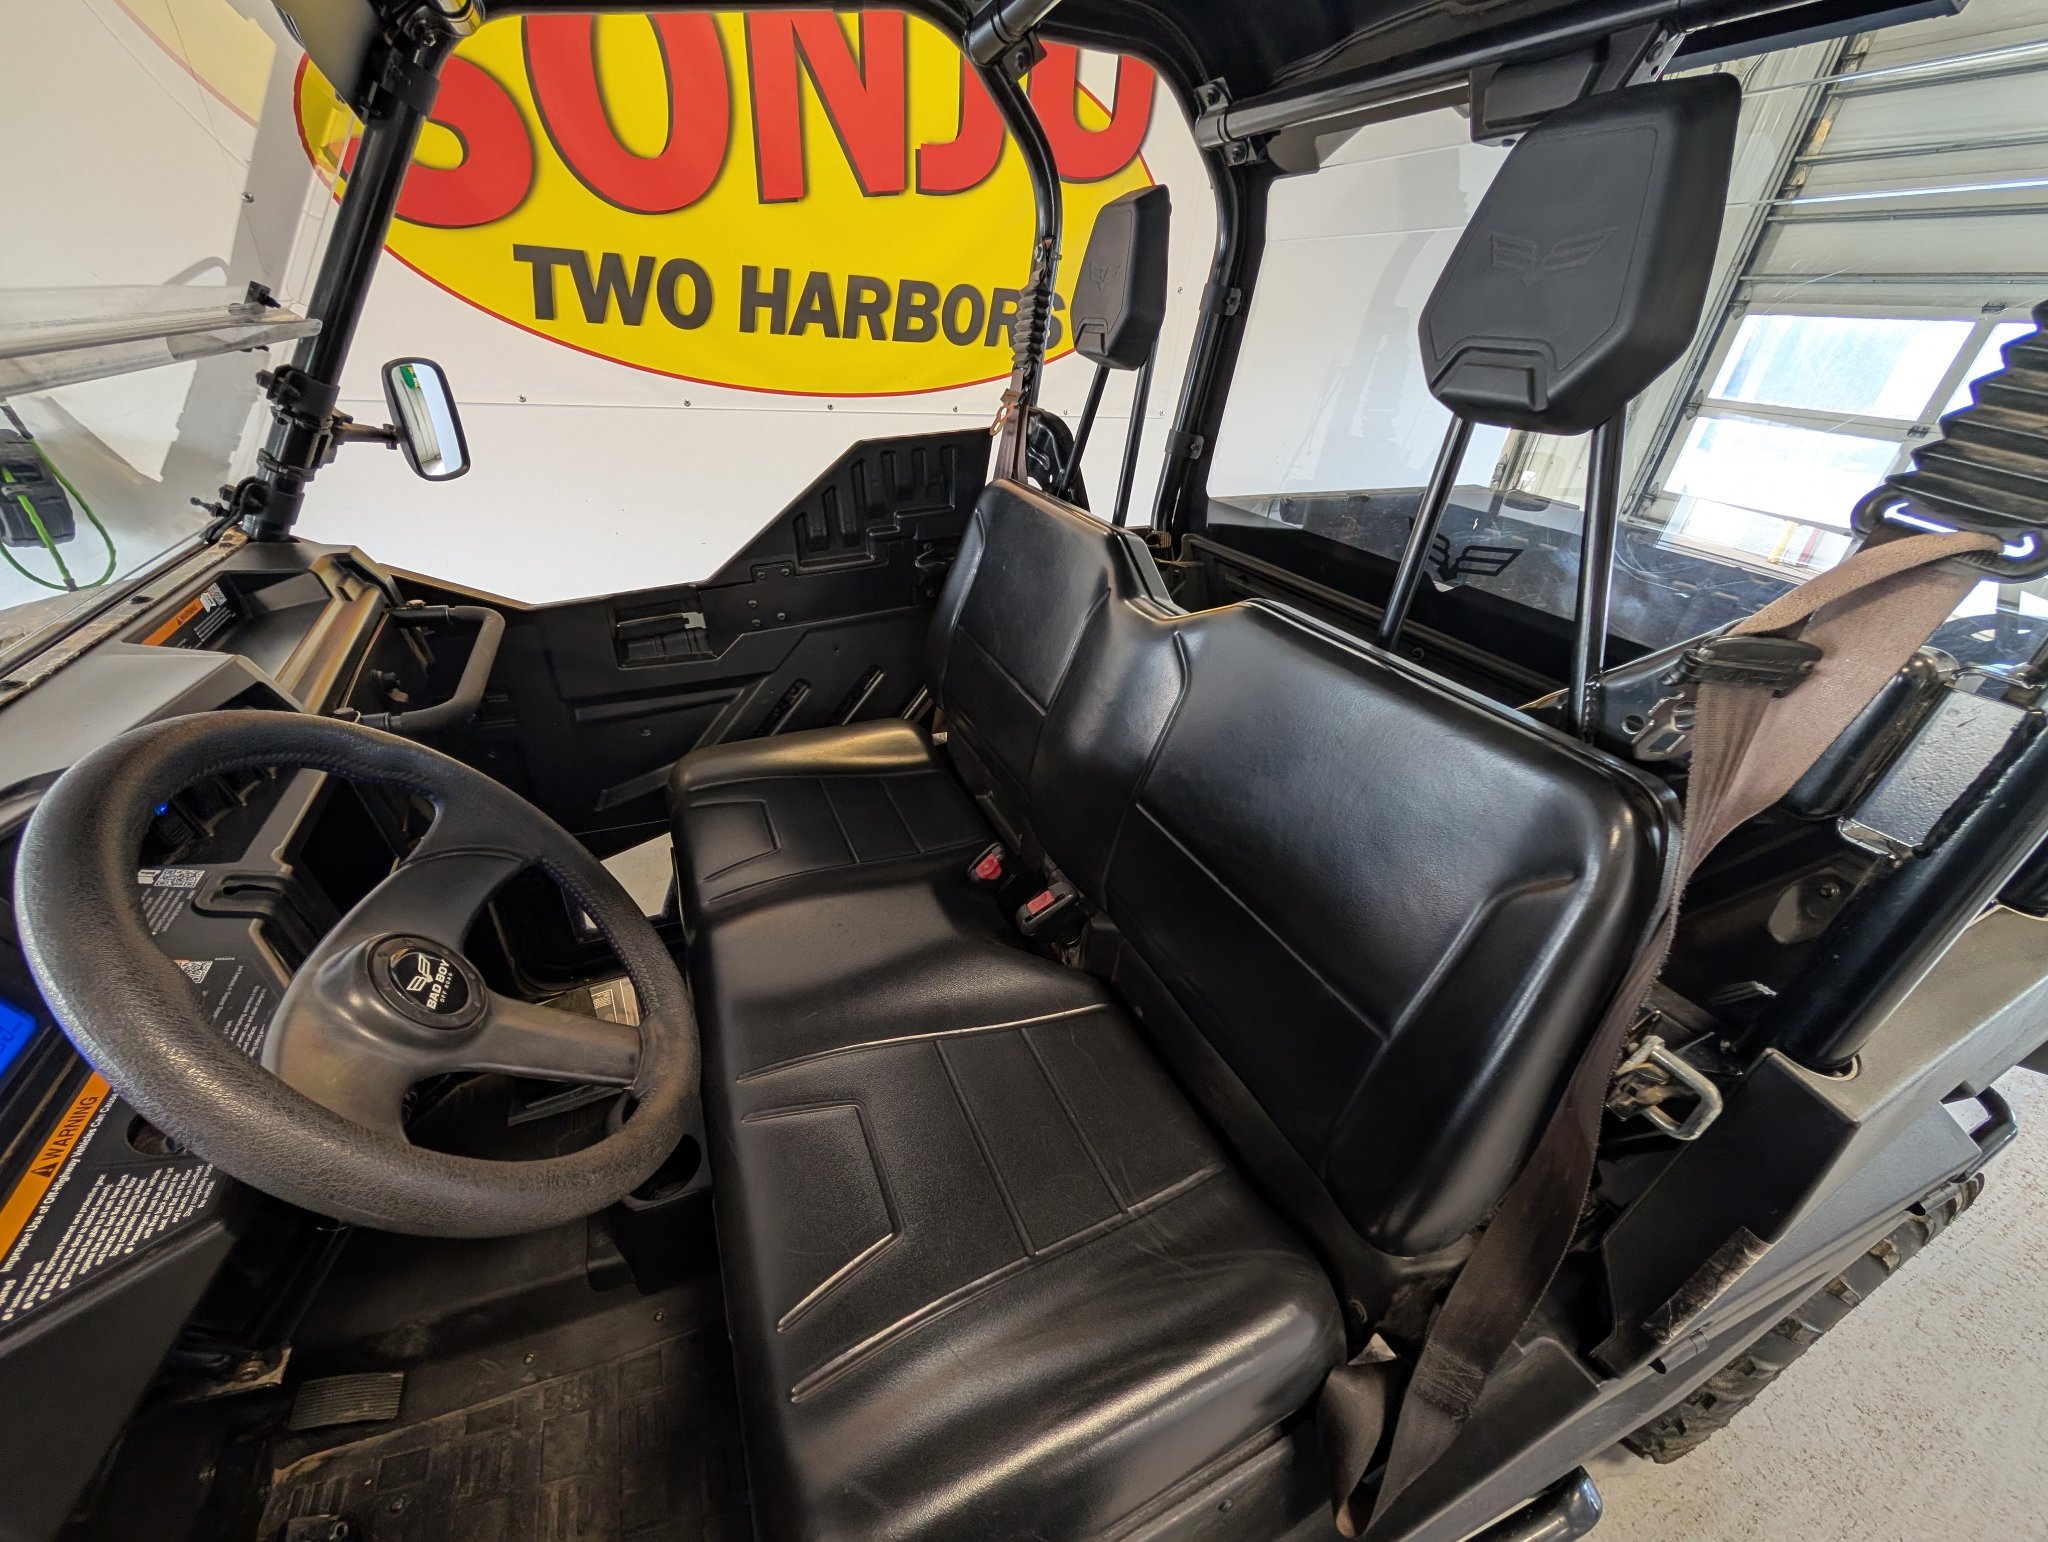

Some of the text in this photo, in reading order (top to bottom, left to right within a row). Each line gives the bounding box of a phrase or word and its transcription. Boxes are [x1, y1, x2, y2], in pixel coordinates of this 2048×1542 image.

[512, 244, 713, 328] TWO
[426, 959, 450, 1010] BAD BOY
[440, 972, 453, 1003] OFF ROAD
[43, 1095, 99, 1162] WARNING
[90, 1114, 106, 1127] Can
[71, 1126, 97, 1158] Vehicles
[43, 1158, 81, 1204] Off-Highway
[25, 1215, 44, 1232] Use
[39, 1205, 50, 1214] of
[1, 1232, 33, 1271] Improper
